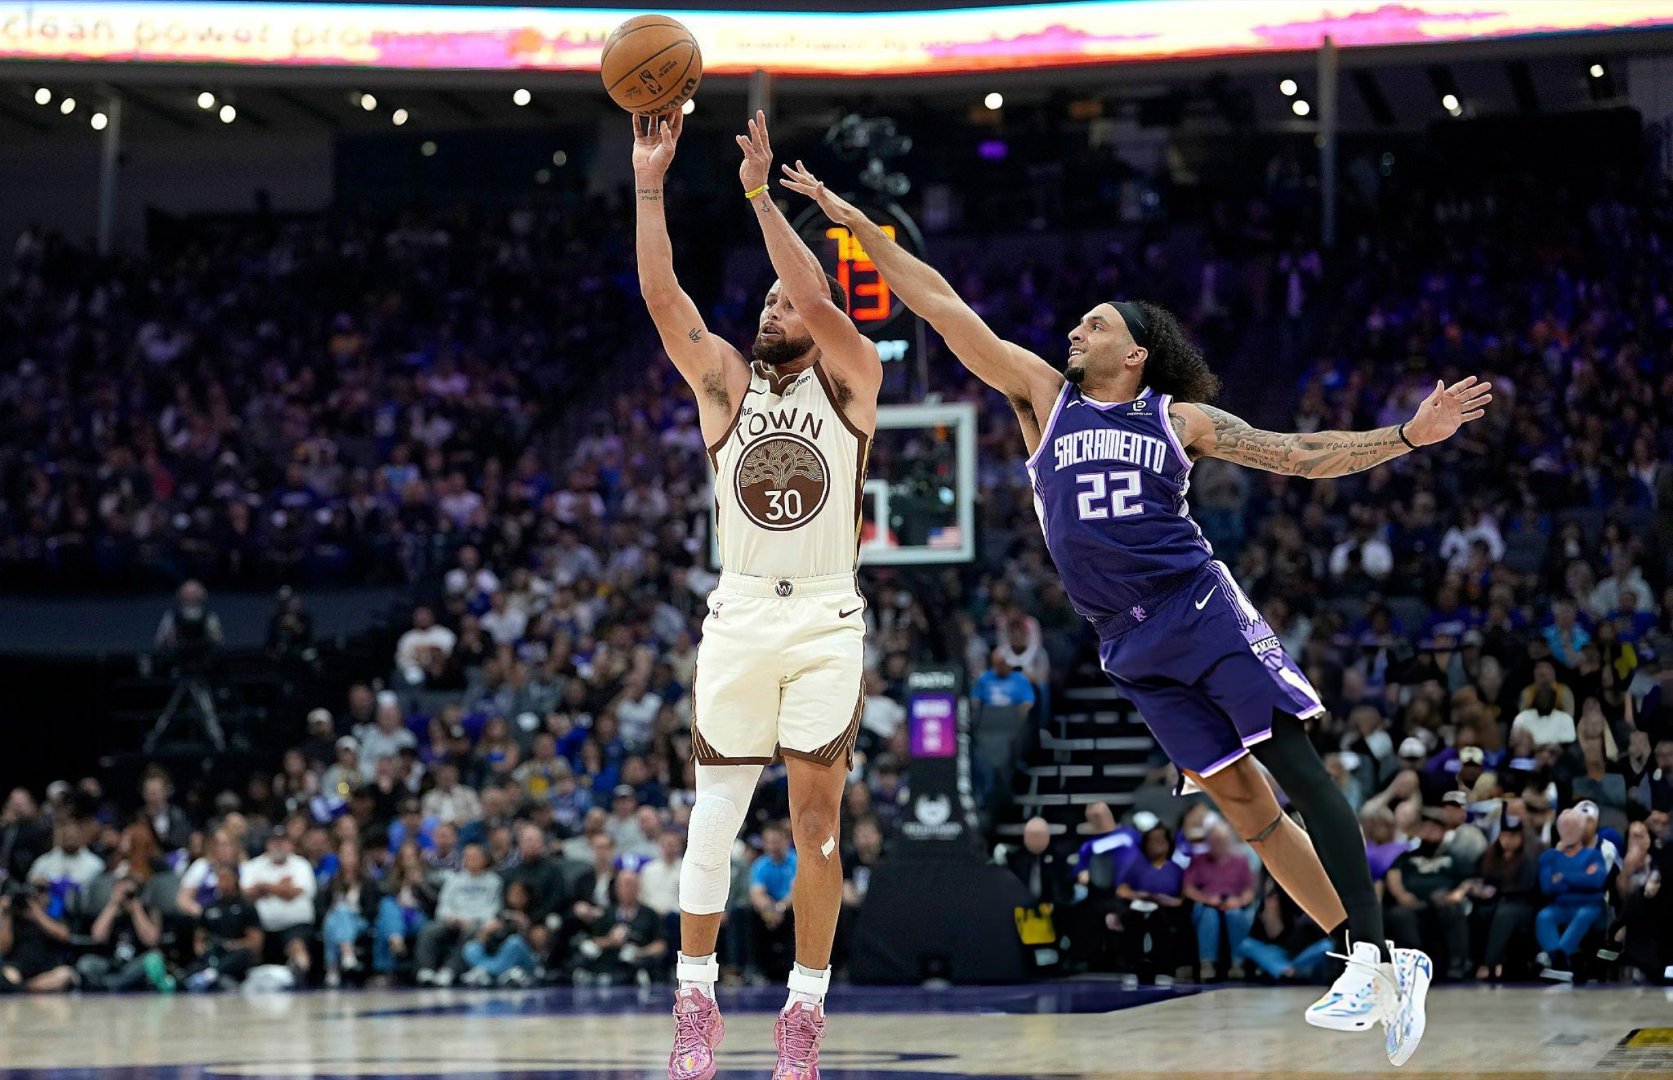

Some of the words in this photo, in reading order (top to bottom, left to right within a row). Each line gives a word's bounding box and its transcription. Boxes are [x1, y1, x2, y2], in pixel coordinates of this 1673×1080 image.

[734, 407, 824, 447] TOWN
[1054, 428, 1167, 474] SACRAMENTO
[764, 488, 802, 521] 30
[1076, 470, 1144, 521] 22
